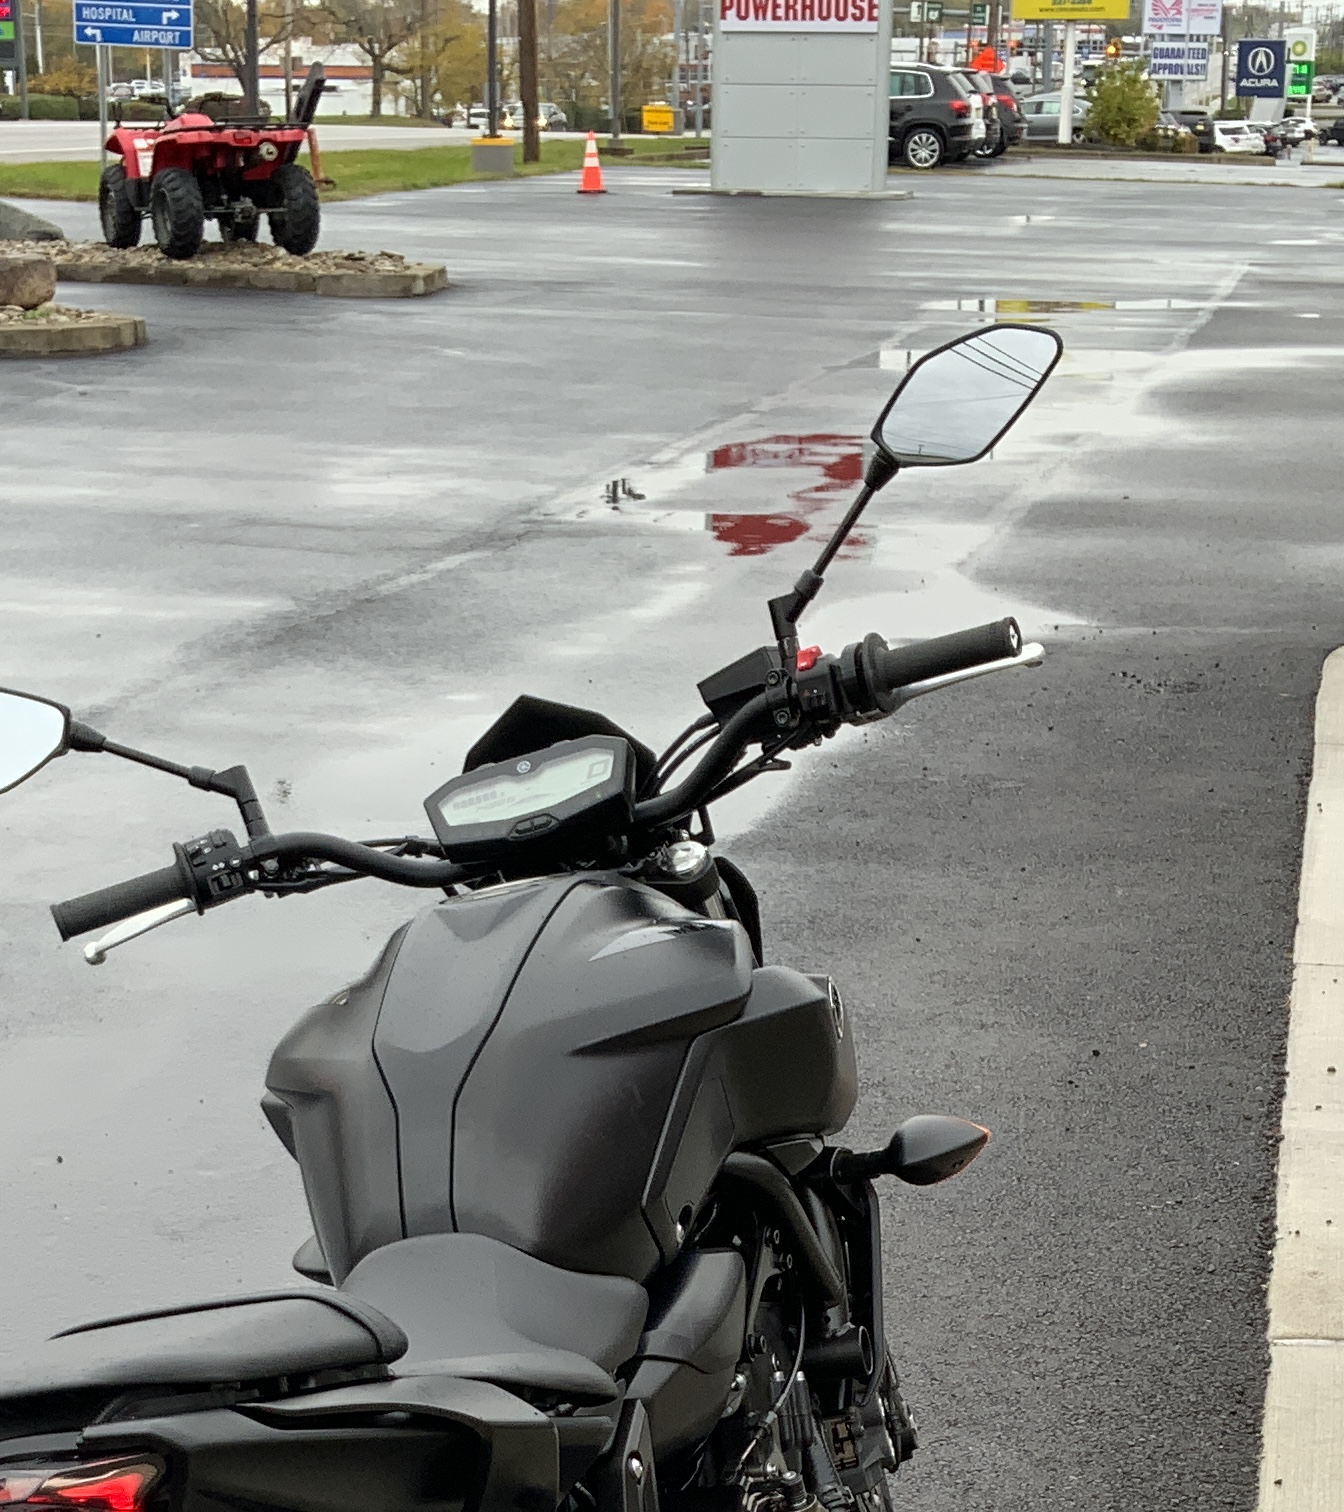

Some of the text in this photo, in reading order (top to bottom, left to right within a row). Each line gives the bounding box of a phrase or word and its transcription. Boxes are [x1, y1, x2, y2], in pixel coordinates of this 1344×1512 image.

[82, 7, 136, 21] HOSPITAL
[720, 0, 879, 21] POWERHOUSE
[132, 30, 181, 44] AIRPORT
[1240, 78, 1279, 87] ACURA
